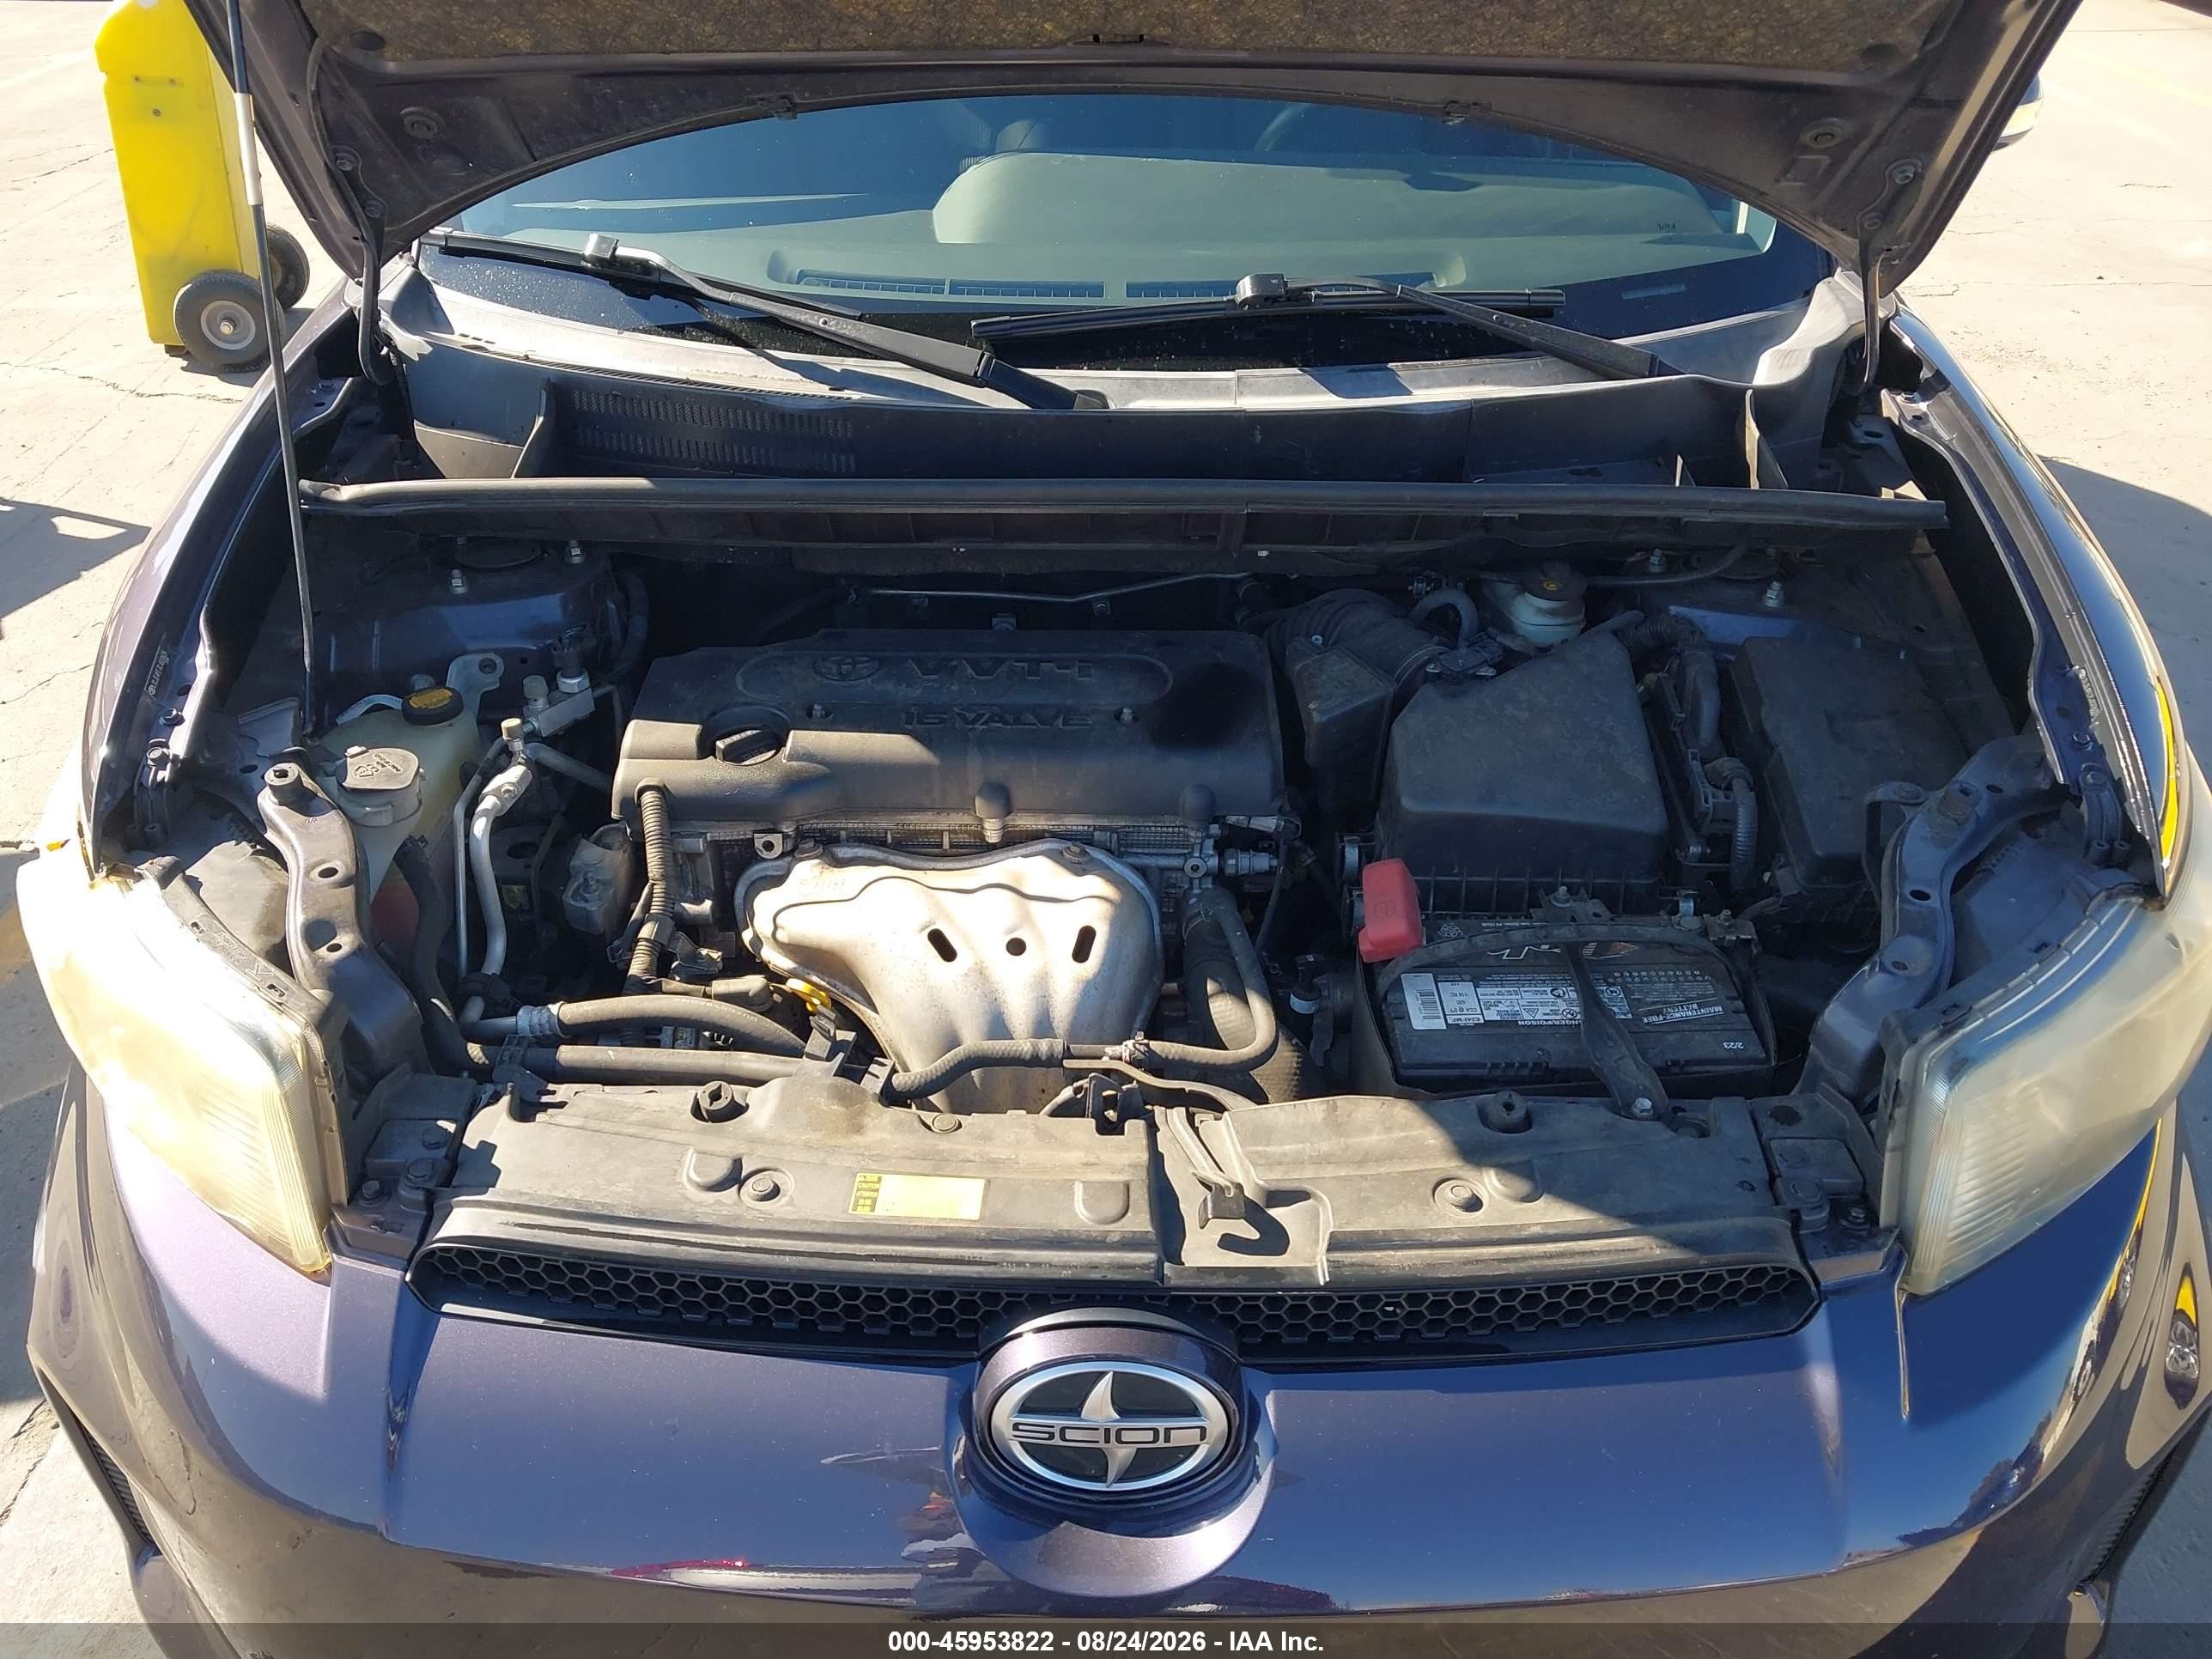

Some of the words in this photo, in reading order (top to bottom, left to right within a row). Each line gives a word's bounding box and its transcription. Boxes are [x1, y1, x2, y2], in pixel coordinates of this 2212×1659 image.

[953, 709, 1093, 729] VALVE
[1641, 1005, 1723, 1024] MAINTENANCE-FREE
[1662, 1003, 1698, 1014] BATTERY
